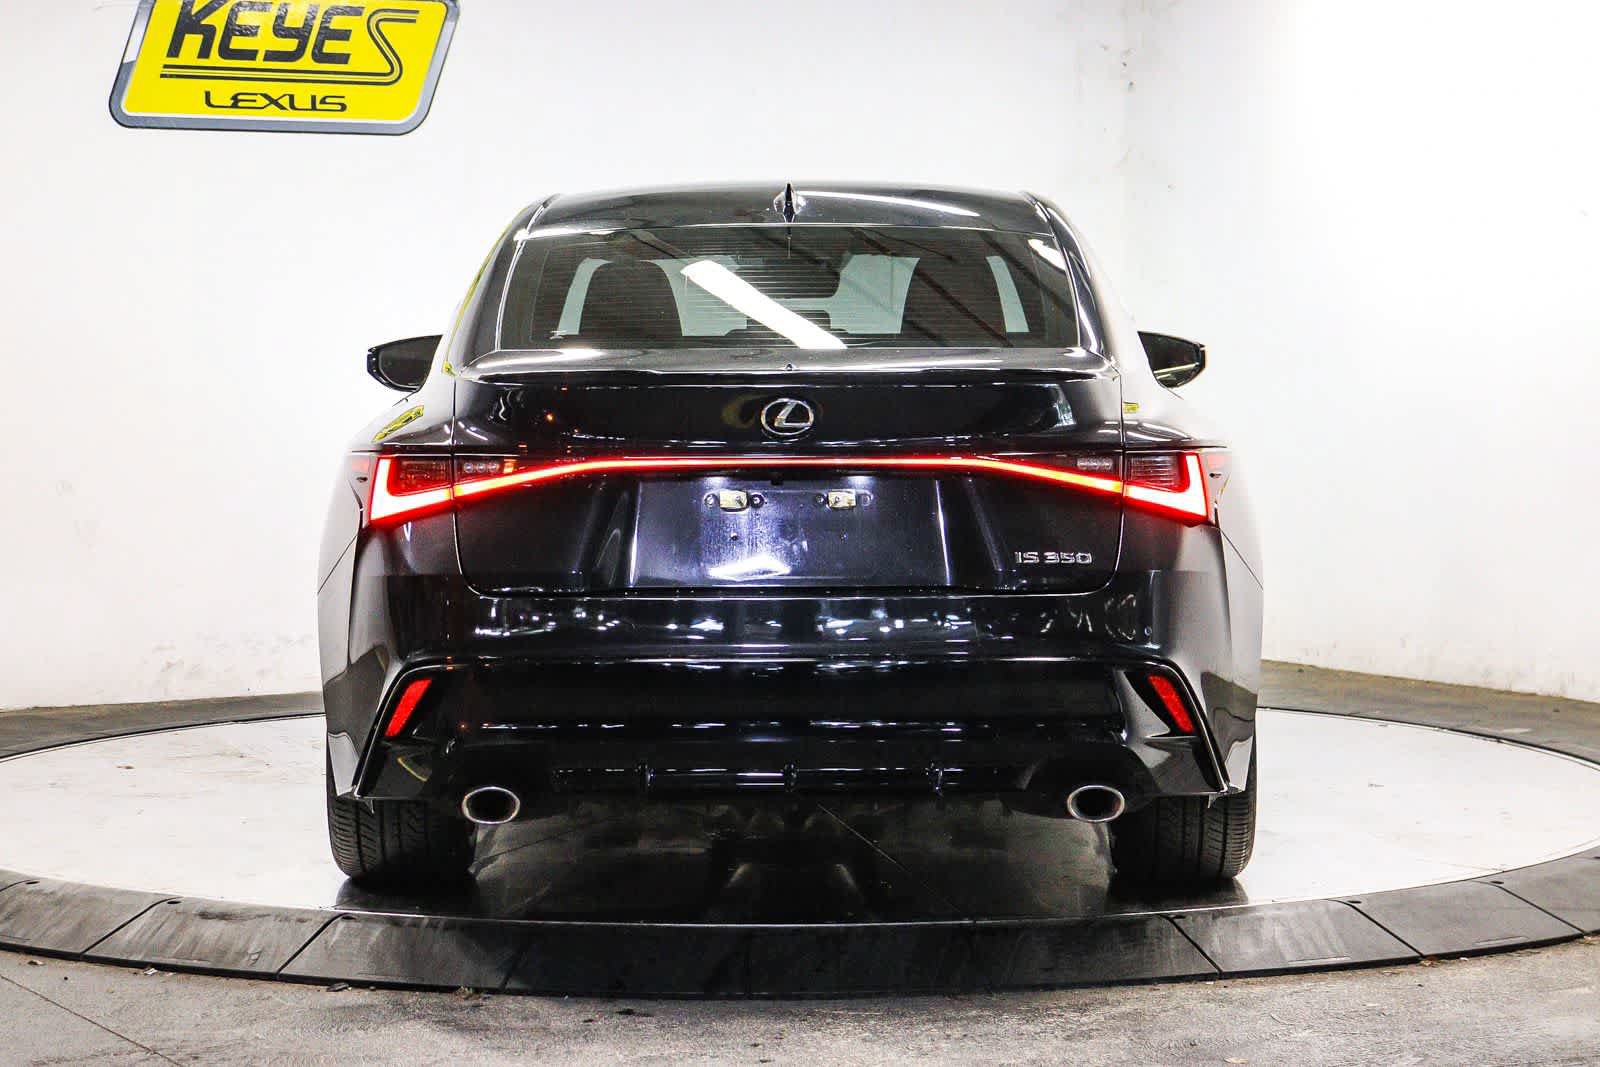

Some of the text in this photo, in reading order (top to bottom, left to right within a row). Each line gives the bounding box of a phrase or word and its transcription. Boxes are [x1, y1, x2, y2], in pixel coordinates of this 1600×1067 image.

[161, 0, 420, 85] KEYES
[204, 90, 348, 113] LEXUS
[1014, 551, 1093, 564] IS 350
